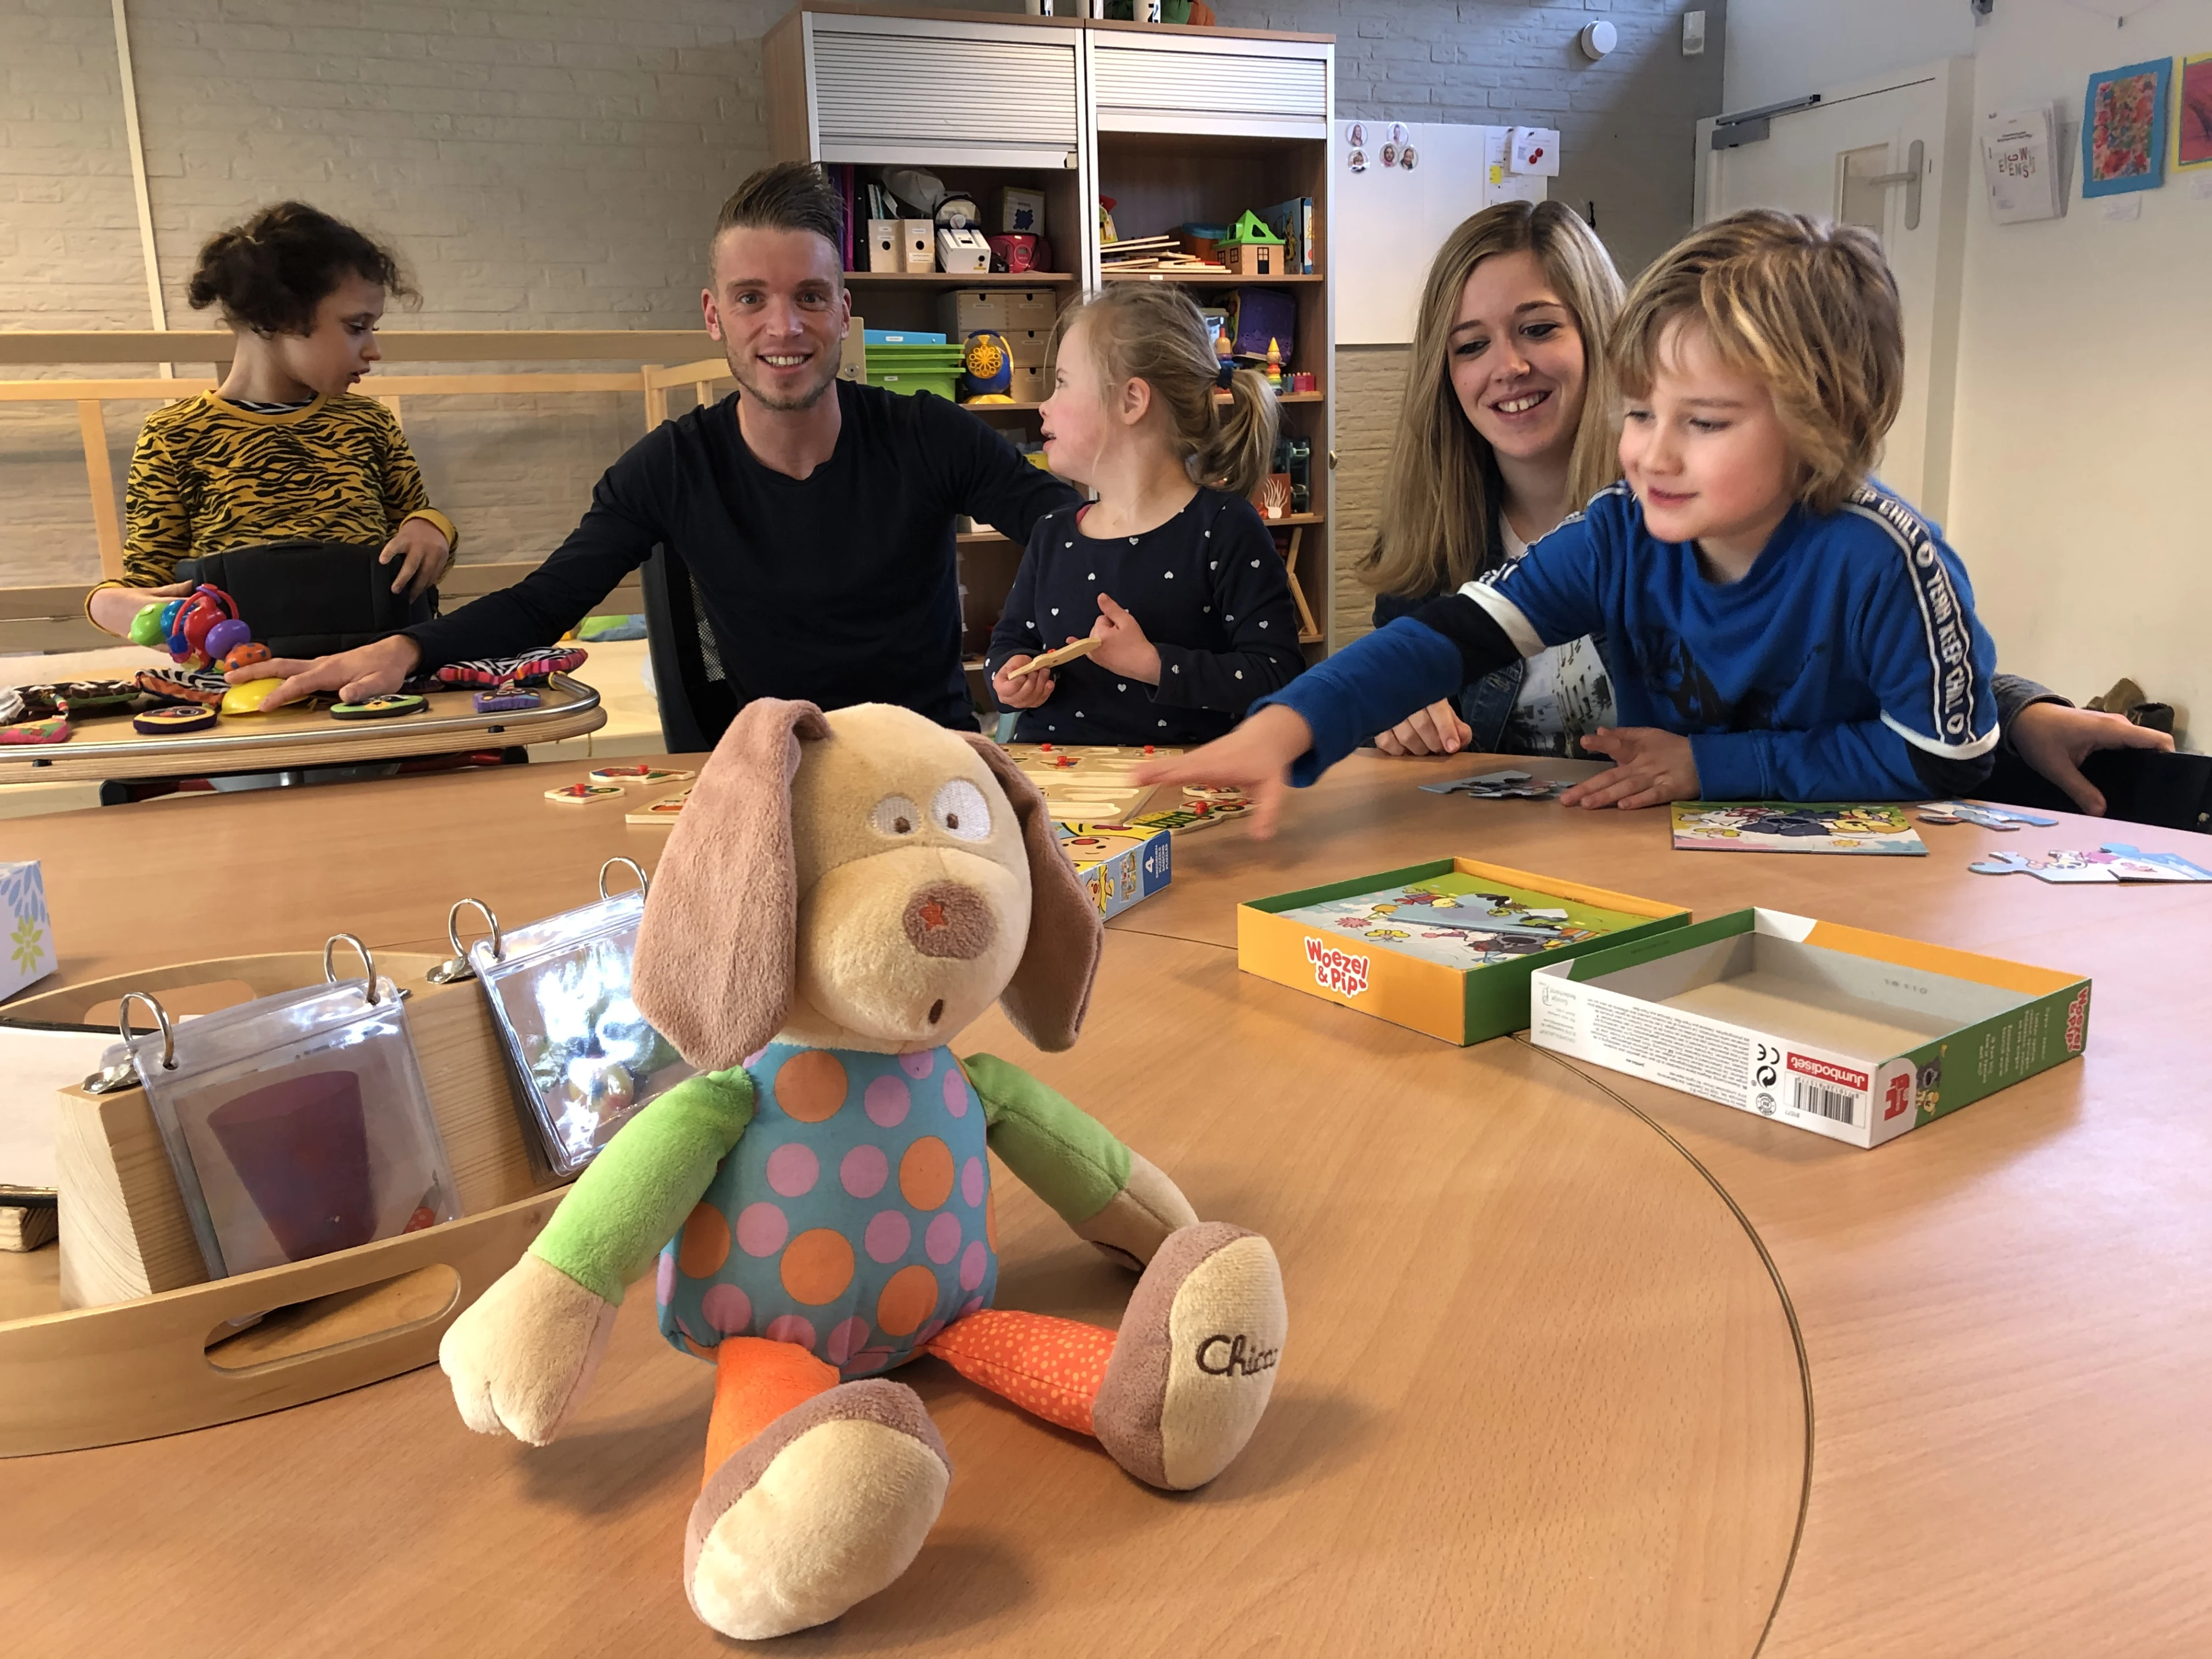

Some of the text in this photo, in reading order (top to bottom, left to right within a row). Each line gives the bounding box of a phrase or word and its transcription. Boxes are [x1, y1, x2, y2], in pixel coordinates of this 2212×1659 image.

[1938, 619, 1964, 666] KEEP
[1945, 666, 1967, 714] CHILL
[1145, 856, 1154, 873] 4
[1306, 940, 1368, 979] Woezel
[1318, 965, 1358, 996] & Pip
[1791, 1056, 1865, 1087] Jumbodiset
